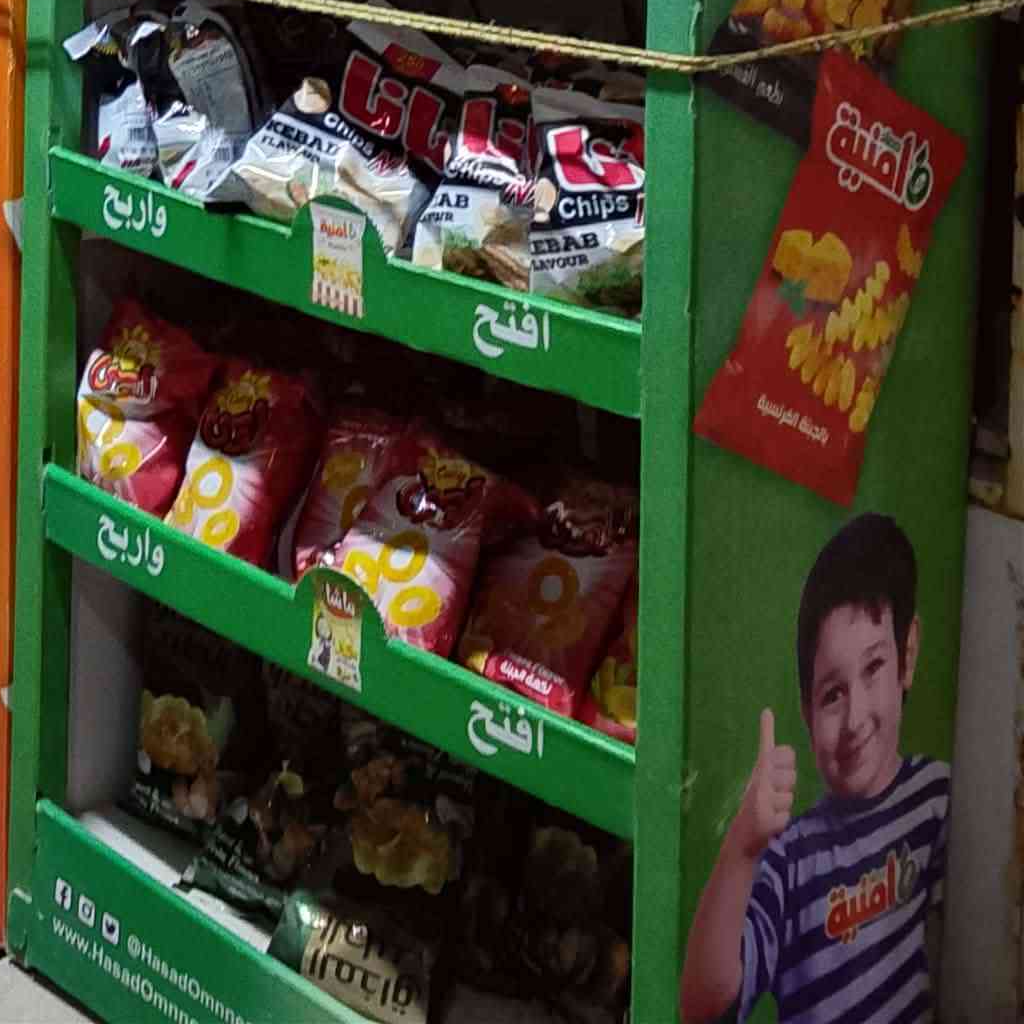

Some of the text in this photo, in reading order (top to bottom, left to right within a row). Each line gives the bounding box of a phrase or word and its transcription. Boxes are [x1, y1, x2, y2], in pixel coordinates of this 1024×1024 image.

[323, 112, 373, 160] Chips
[558, 192, 629, 222] Chips
[103, 184, 549, 358] افتح واربح
[97, 512, 545, 759] افتح واربح
